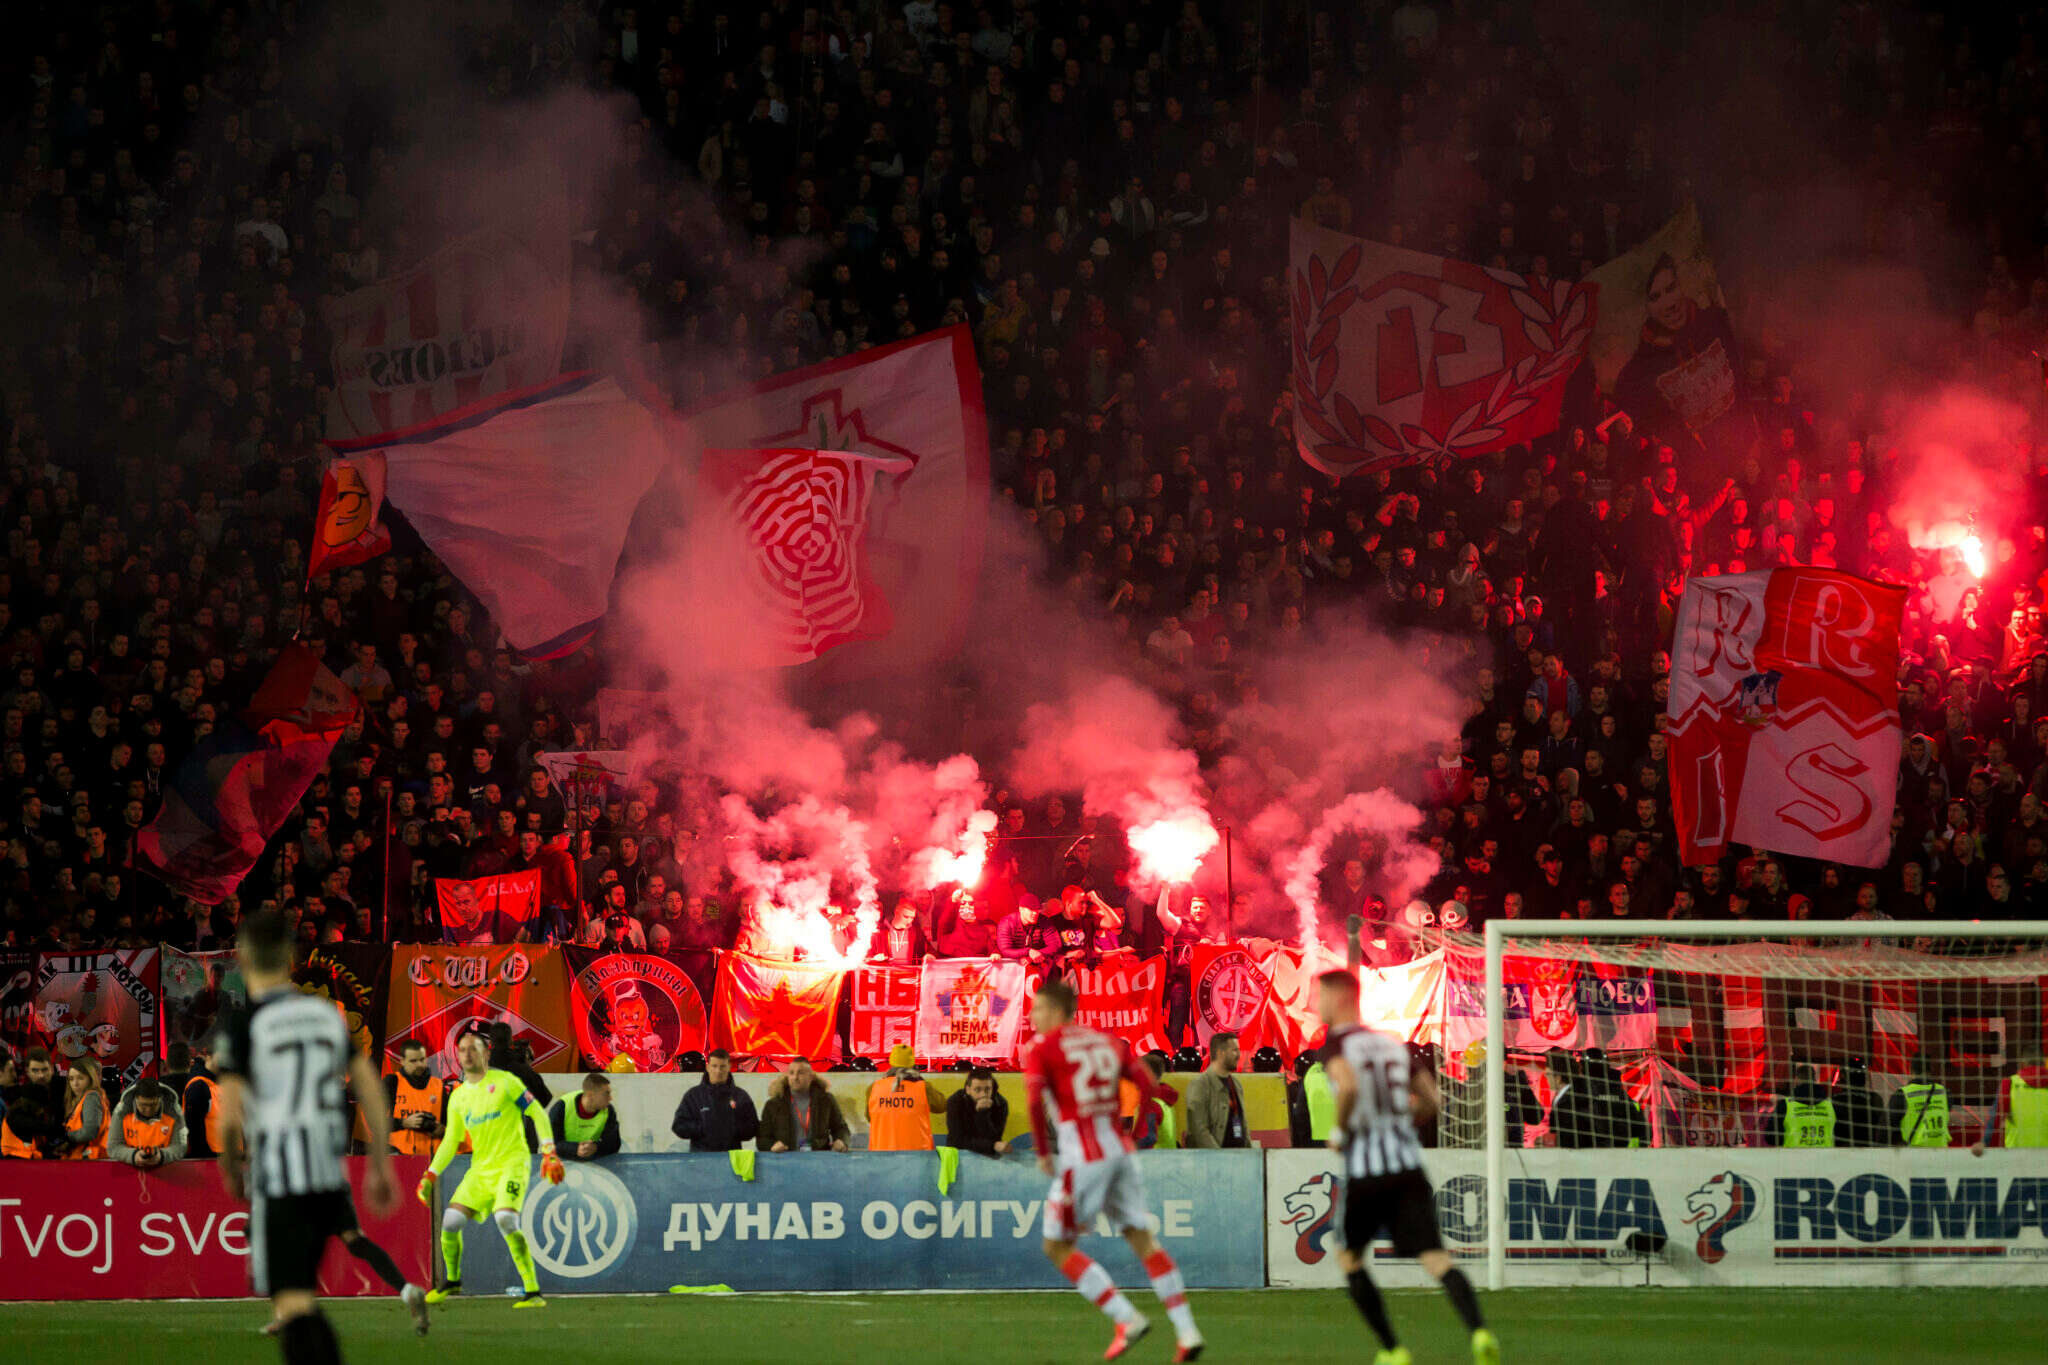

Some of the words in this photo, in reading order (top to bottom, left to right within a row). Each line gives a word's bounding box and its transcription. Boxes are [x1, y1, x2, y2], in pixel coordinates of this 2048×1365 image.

[1784, 575, 1876, 678] R
[1775, 742, 1871, 842] S
[108, 958, 154, 1015] MOSCOW
[940, 1031, 998, 1046] ПРЕДАЈЕ
[950, 1020, 989, 1032] НЕМА
[1066, 1047, 1120, 1103] 29
[878, 1096, 914, 1109] PHOTO
[506, 1180, 521, 1197] 82
[1774, 1174, 2048, 1242] ROMA
[663, 1202, 846, 1252] ДУНАВ
